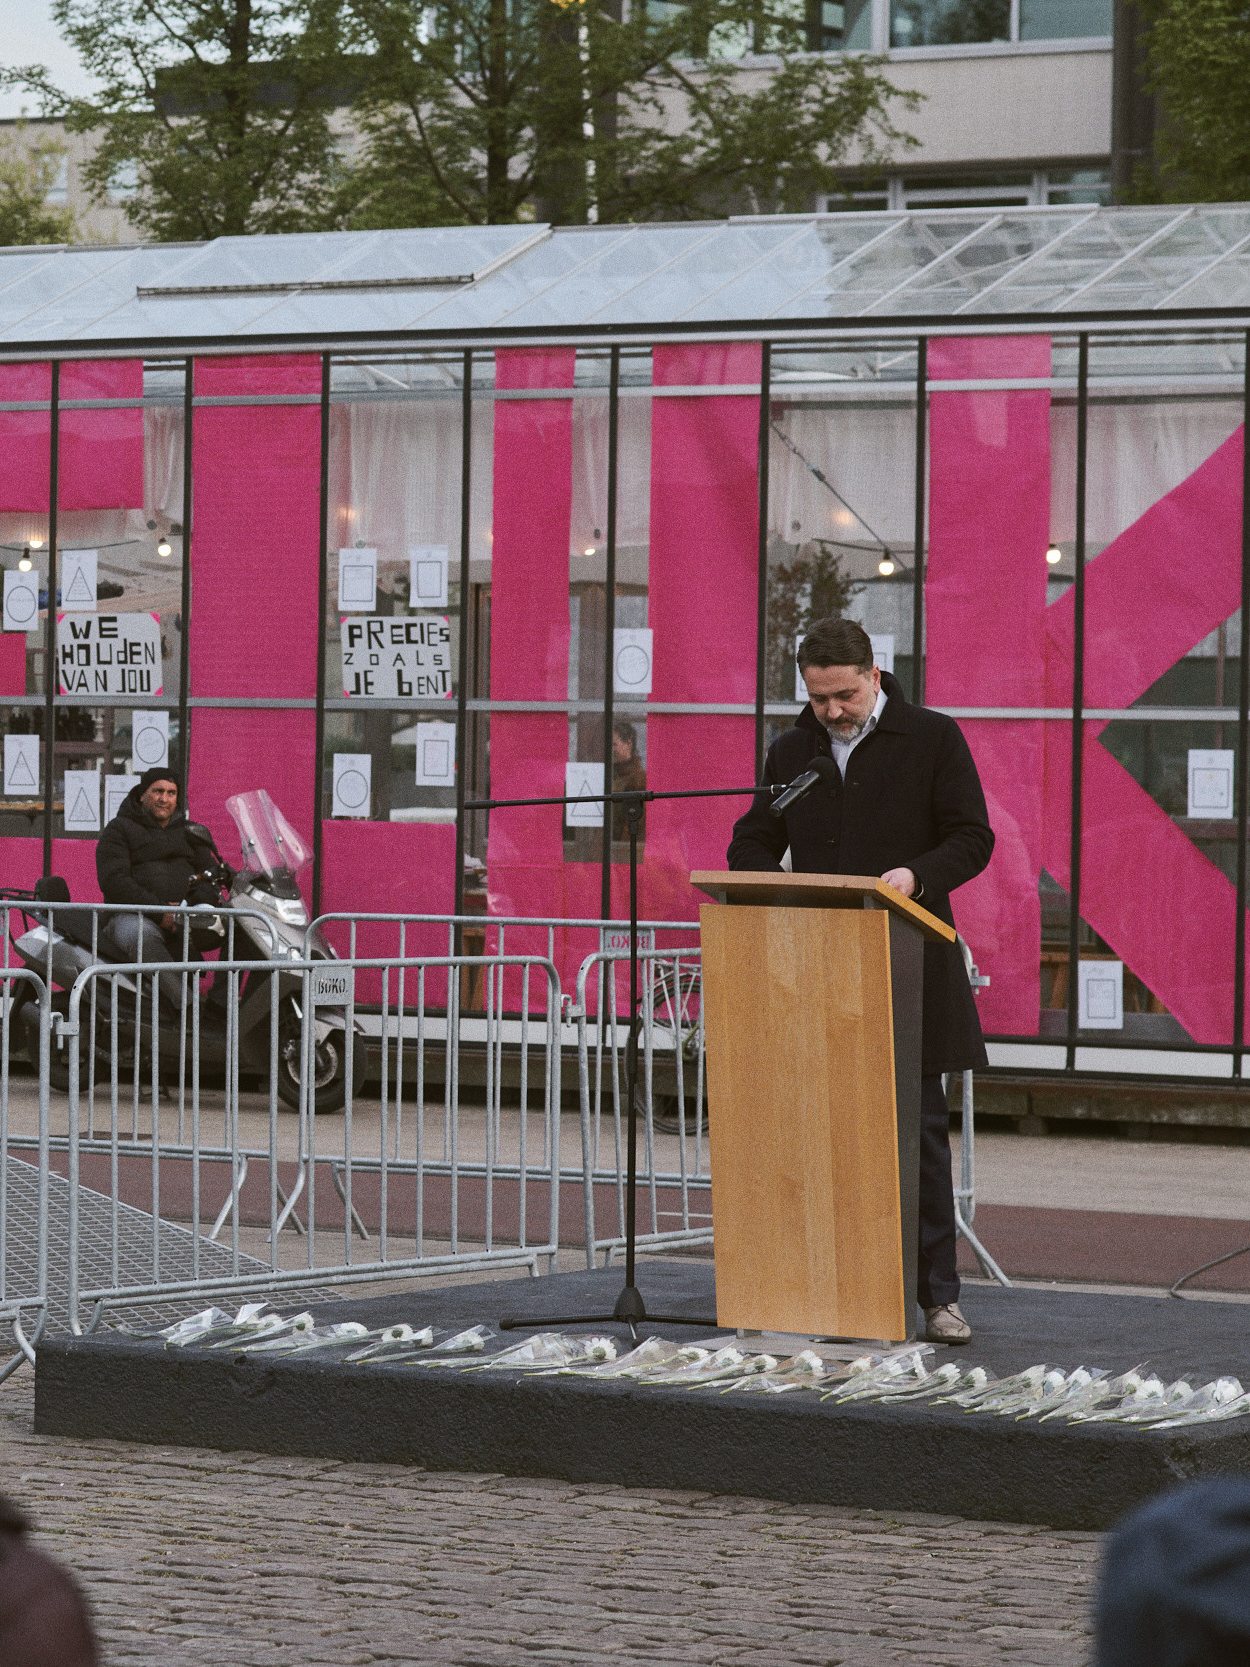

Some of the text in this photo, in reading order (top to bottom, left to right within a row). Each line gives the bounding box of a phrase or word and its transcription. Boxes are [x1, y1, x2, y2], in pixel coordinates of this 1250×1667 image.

[69, 616, 119, 640] WE
[347, 620, 450, 650] PRECIES
[61, 668, 151, 693] VAN JOU
[349, 670, 375, 695] JE
